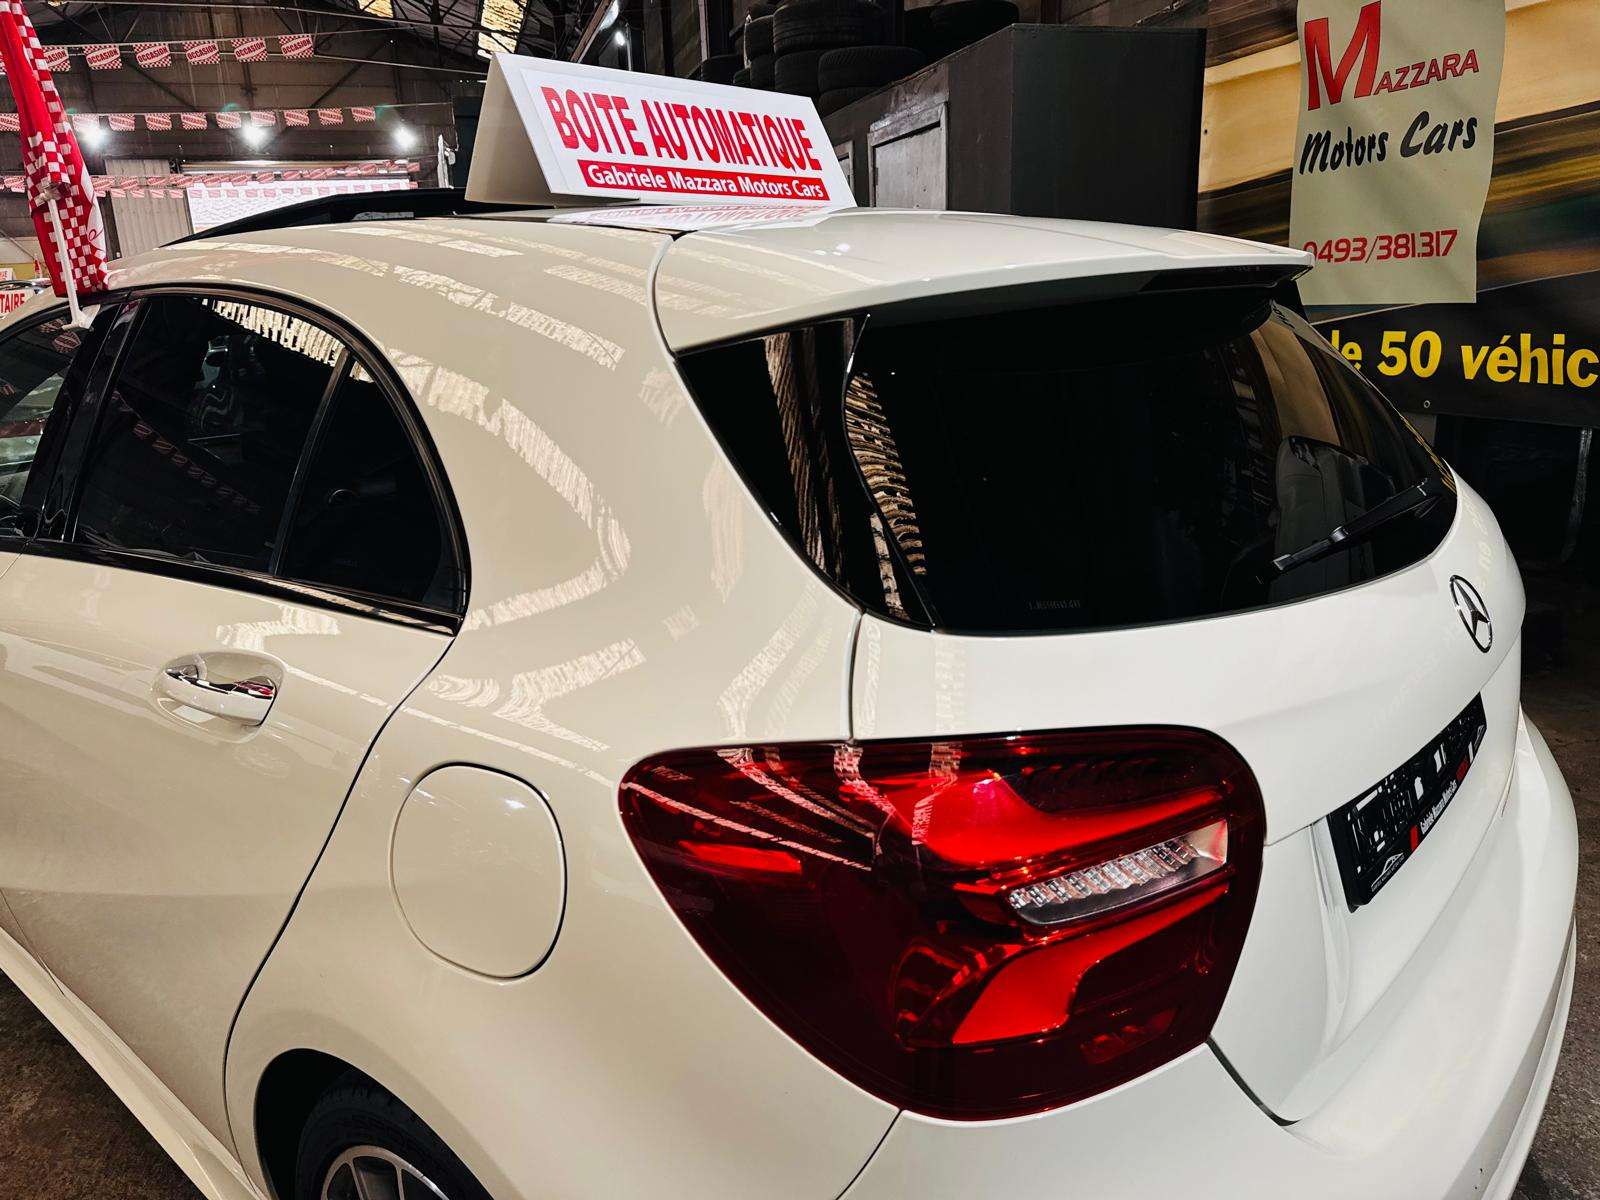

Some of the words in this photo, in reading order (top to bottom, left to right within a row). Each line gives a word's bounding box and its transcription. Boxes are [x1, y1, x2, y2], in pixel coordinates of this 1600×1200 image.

[87, 48, 119, 65] OCCASION
[137, 46, 169, 62] OCCASION
[187, 44, 217, 60] OCCASION
[235, 41, 265, 58] OCCASION
[282, 38, 312, 55] OCCASION
[1304, 0, 1479, 111] MAZZARA
[541, 87, 648, 157] BOITE
[641, 99, 822, 174] AUTOMATIQUE
[1299, 126, 1389, 175] Motors
[1400, 111, 1478, 158] Cars
[587, 165, 667, 189] Gabriele
[669, 170, 739, 193] Mazzara
[738, 176, 790, 196] Motors
[795, 179, 824, 198] Cars
[1378, 330, 1441, 378] 50
[1461, 332, 1599, 387] véhic
